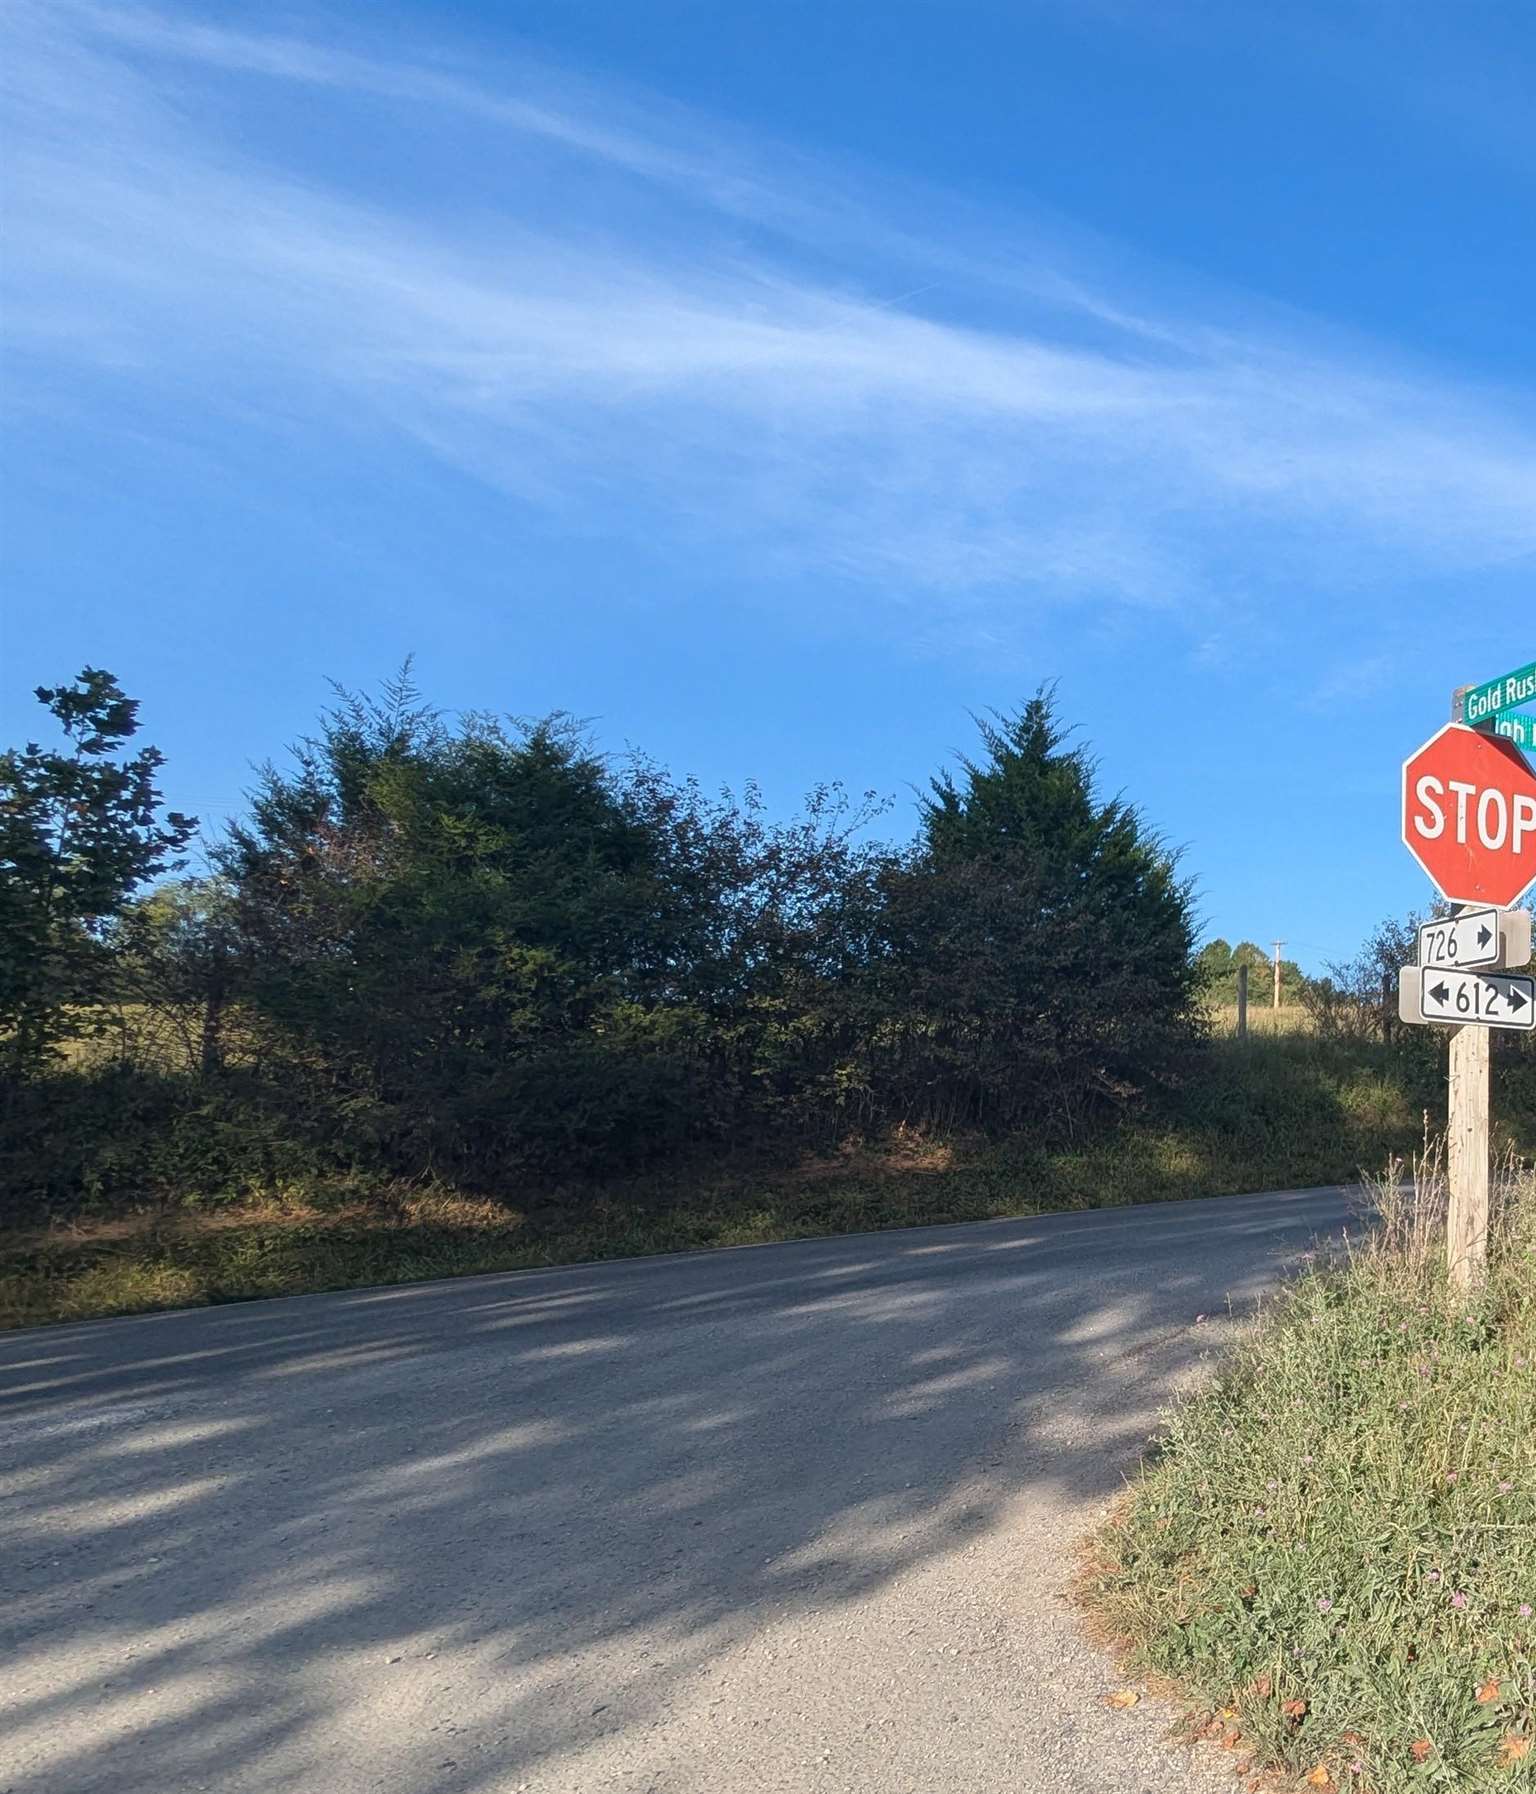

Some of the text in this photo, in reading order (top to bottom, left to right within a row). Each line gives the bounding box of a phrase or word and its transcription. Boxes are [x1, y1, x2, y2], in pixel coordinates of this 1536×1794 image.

[1468, 683, 1501, 720] Gold
[1426, 927, 1458, 964] 726
[1456, 981, 1499, 1016] 612
